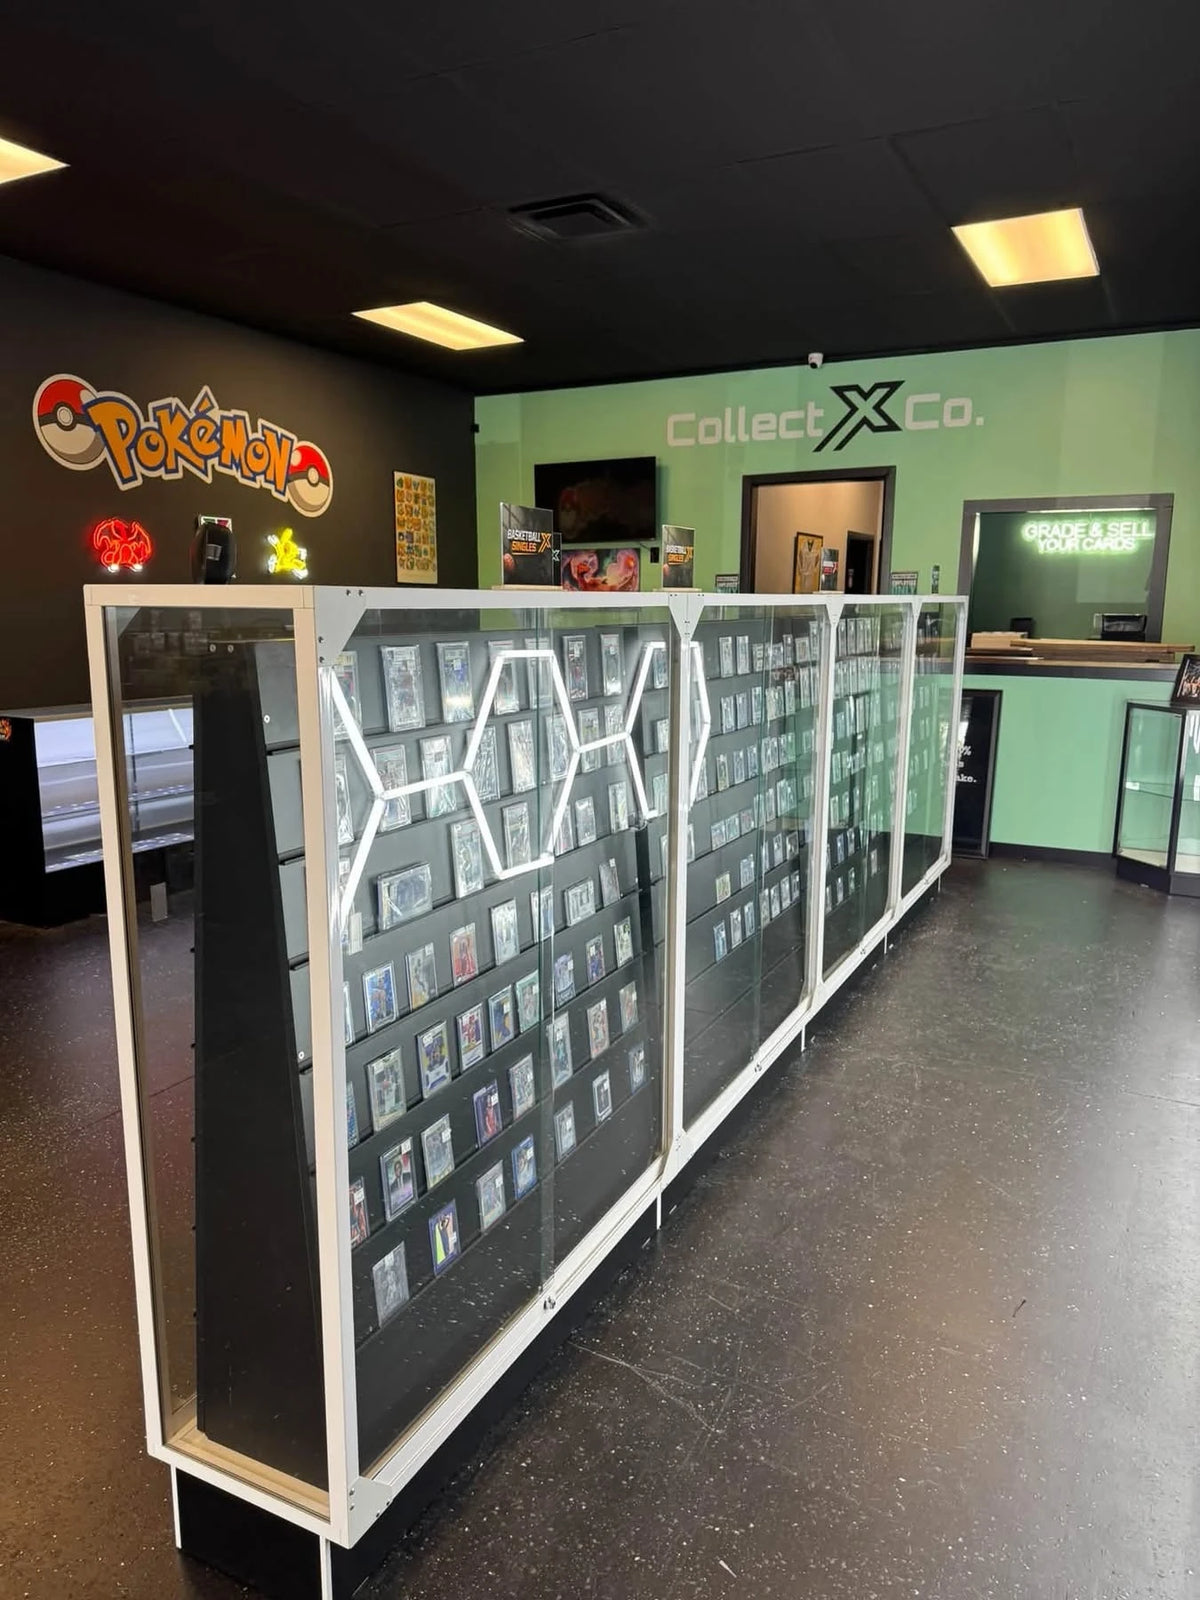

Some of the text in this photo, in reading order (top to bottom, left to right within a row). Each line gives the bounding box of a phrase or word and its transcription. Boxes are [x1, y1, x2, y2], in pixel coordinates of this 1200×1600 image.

[666, 399, 824, 447] Collect
[904, 392, 985, 431] Co.
[507, 528, 541, 543] BASKETBALL
[1023, 519, 1155, 539] GRADE & SELL
[512, 540, 537, 552] SINGLES
[1037, 536, 1138, 553] YOUR CARDS
